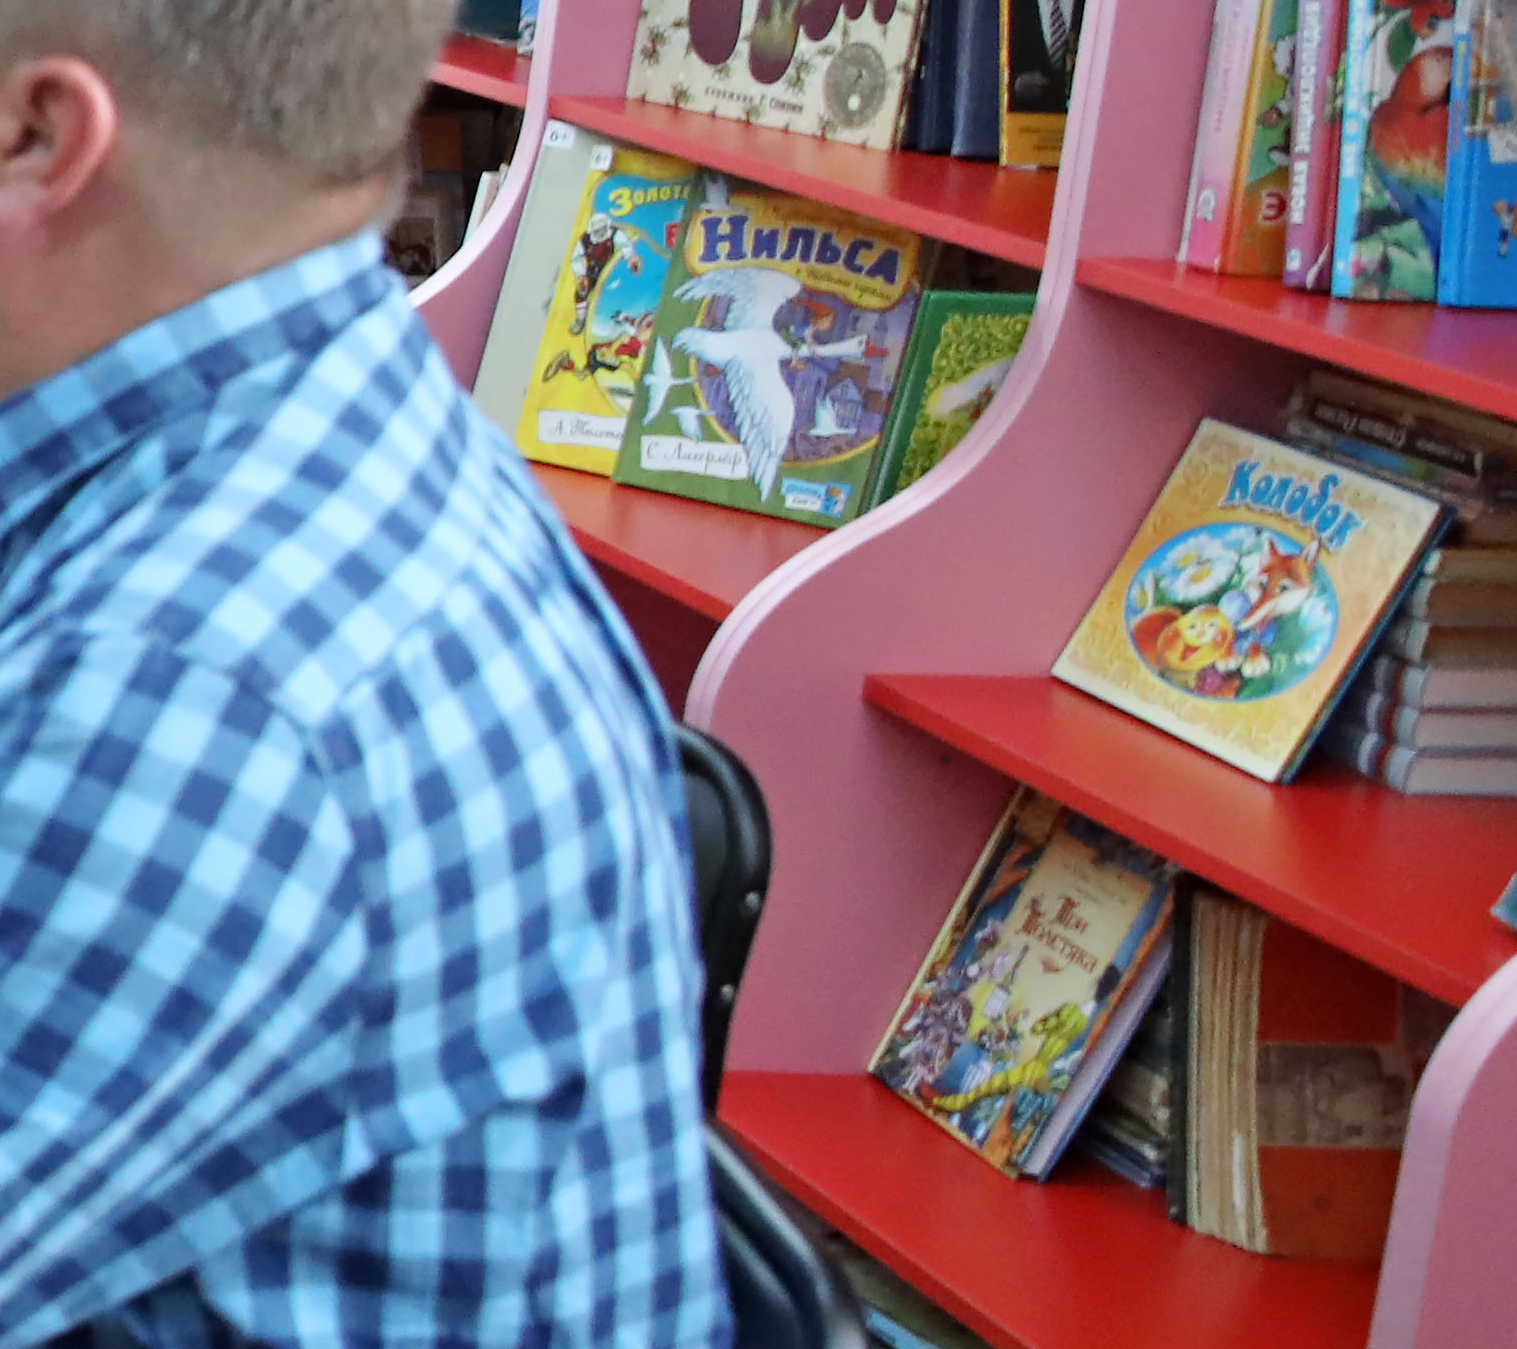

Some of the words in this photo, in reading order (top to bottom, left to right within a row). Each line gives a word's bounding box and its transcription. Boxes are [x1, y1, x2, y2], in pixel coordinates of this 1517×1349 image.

[1293, 0, 1322, 156] ЭНЦИКЛОПЕДИЯ
[1289, 160, 1309, 225] НОВАЯ
[1217, 458, 1367, 554] Колобок
